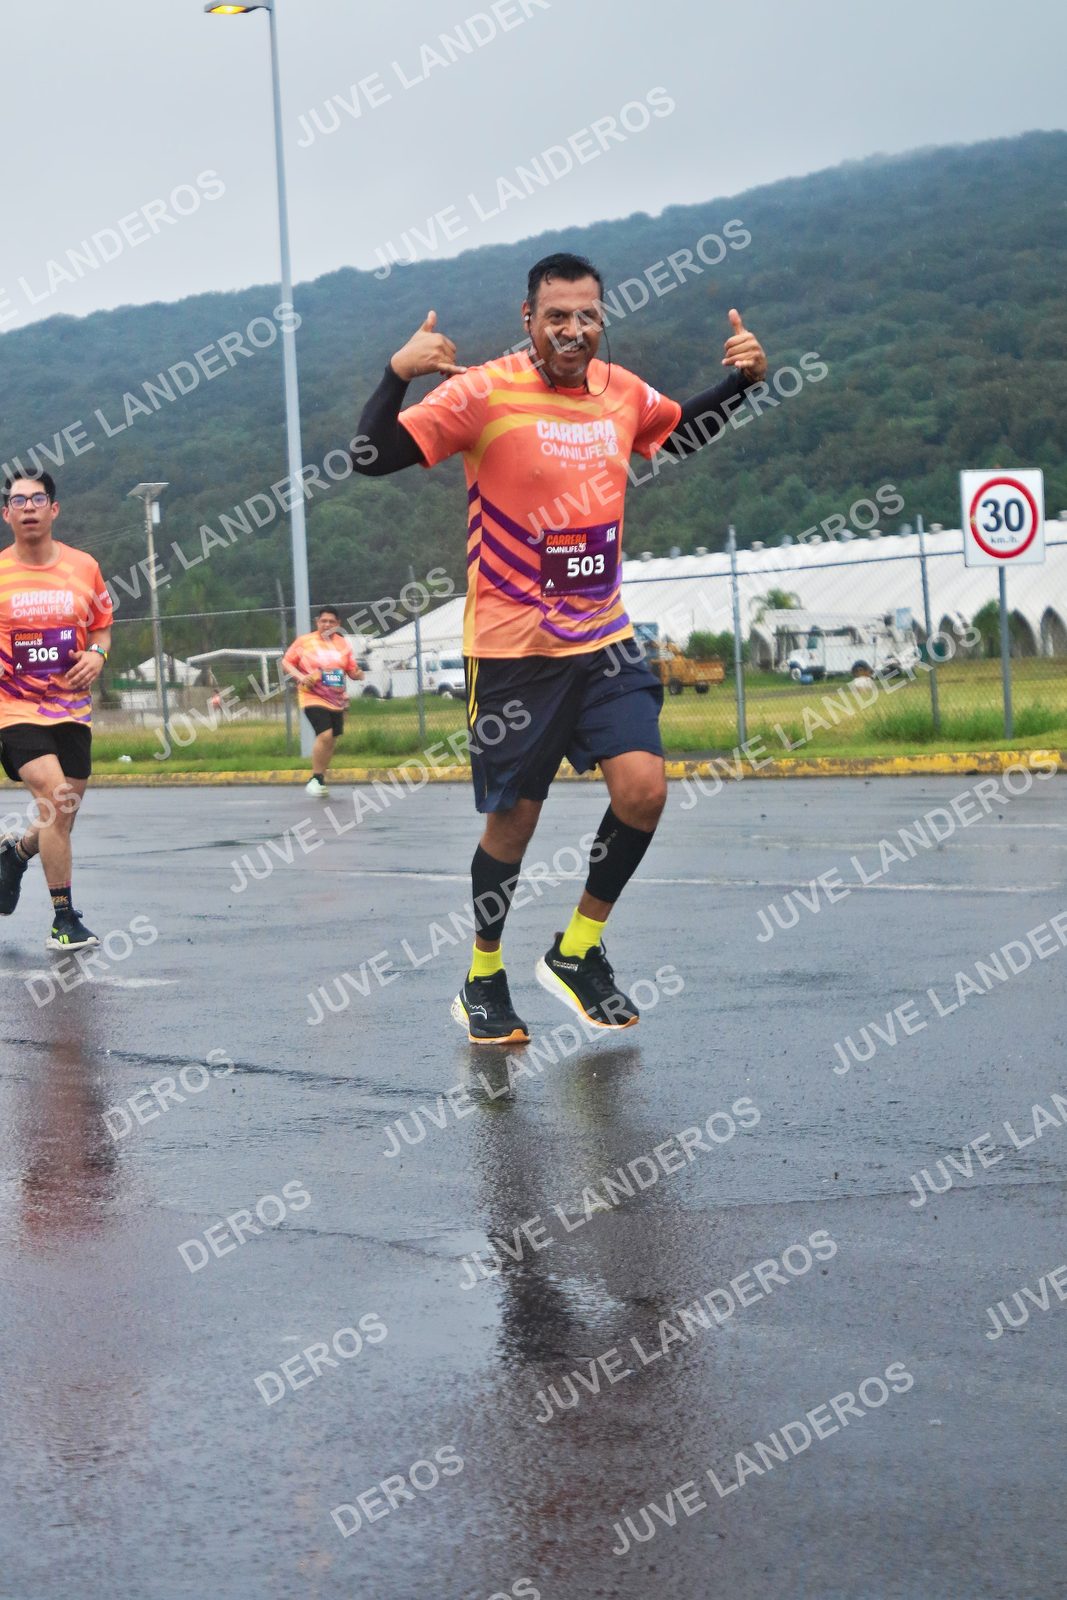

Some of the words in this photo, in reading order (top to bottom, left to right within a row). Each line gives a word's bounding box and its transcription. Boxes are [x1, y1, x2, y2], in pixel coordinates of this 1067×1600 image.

[536, 419, 616, 444] CARRERA
[982, 498, 1024, 532] 30
[547, 533, 586, 546] CARRERA
[567, 554, 604, 577] 503
[12, 590, 74, 608] CARRERA
[28, 647, 58, 662] 306
